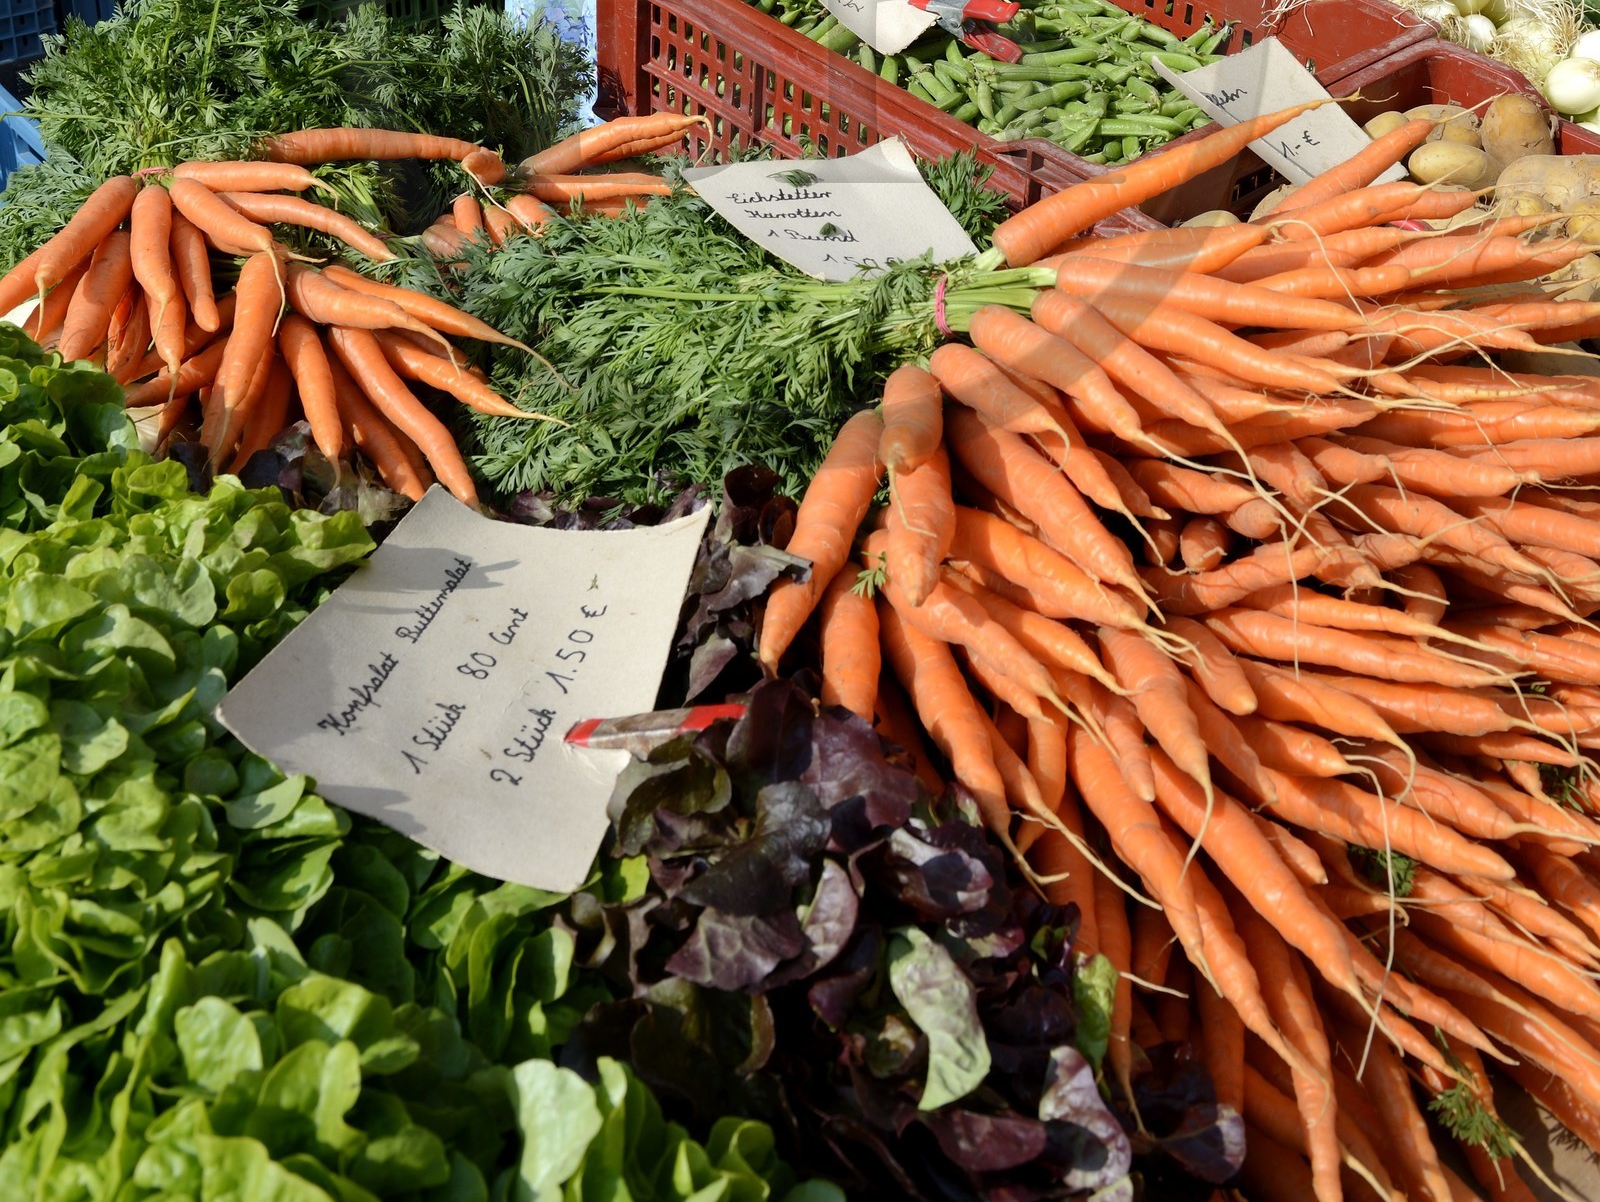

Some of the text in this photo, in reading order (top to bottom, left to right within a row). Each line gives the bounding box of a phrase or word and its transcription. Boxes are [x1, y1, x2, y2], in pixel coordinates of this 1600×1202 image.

[744, 208, 842, 219] Karotten
[783, 228, 861, 243] Bund
[316, 651, 400, 736] Kopfsalat
[400, 606, 529, 775] 1 Stück 80 Cent
[489, 604, 608, 787] 2 Stück 1.50 €
